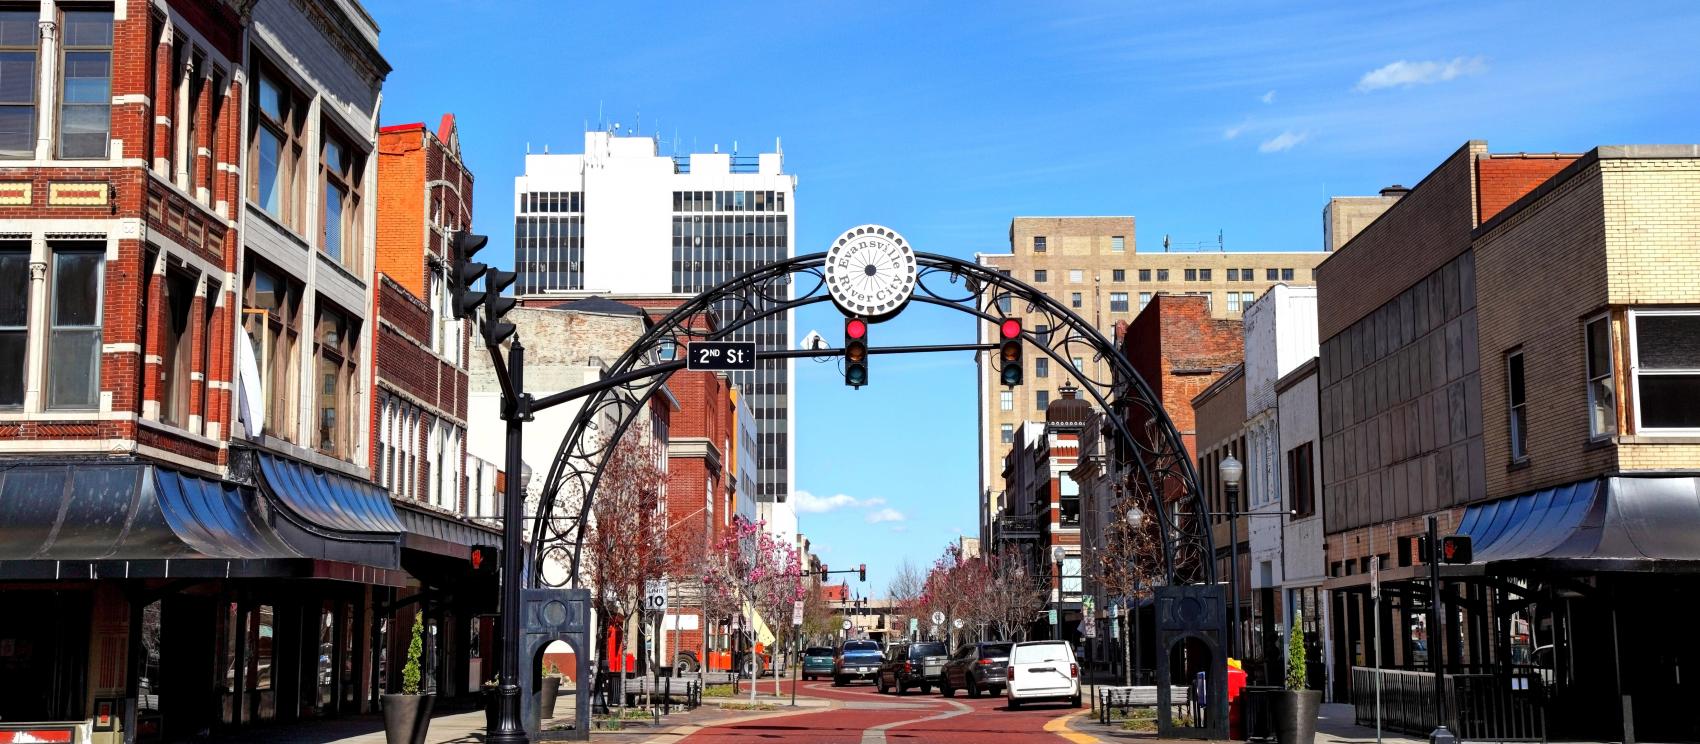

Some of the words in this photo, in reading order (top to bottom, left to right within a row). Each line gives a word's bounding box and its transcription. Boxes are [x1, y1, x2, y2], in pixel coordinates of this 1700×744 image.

[838, 240, 900, 269] Evansville
[839, 274, 873, 302] River
[876, 274, 903, 301] City
[700, 349, 720, 363] 2ND
[727, 349, 744, 363] St
[648, 595, 664, 606] 10
